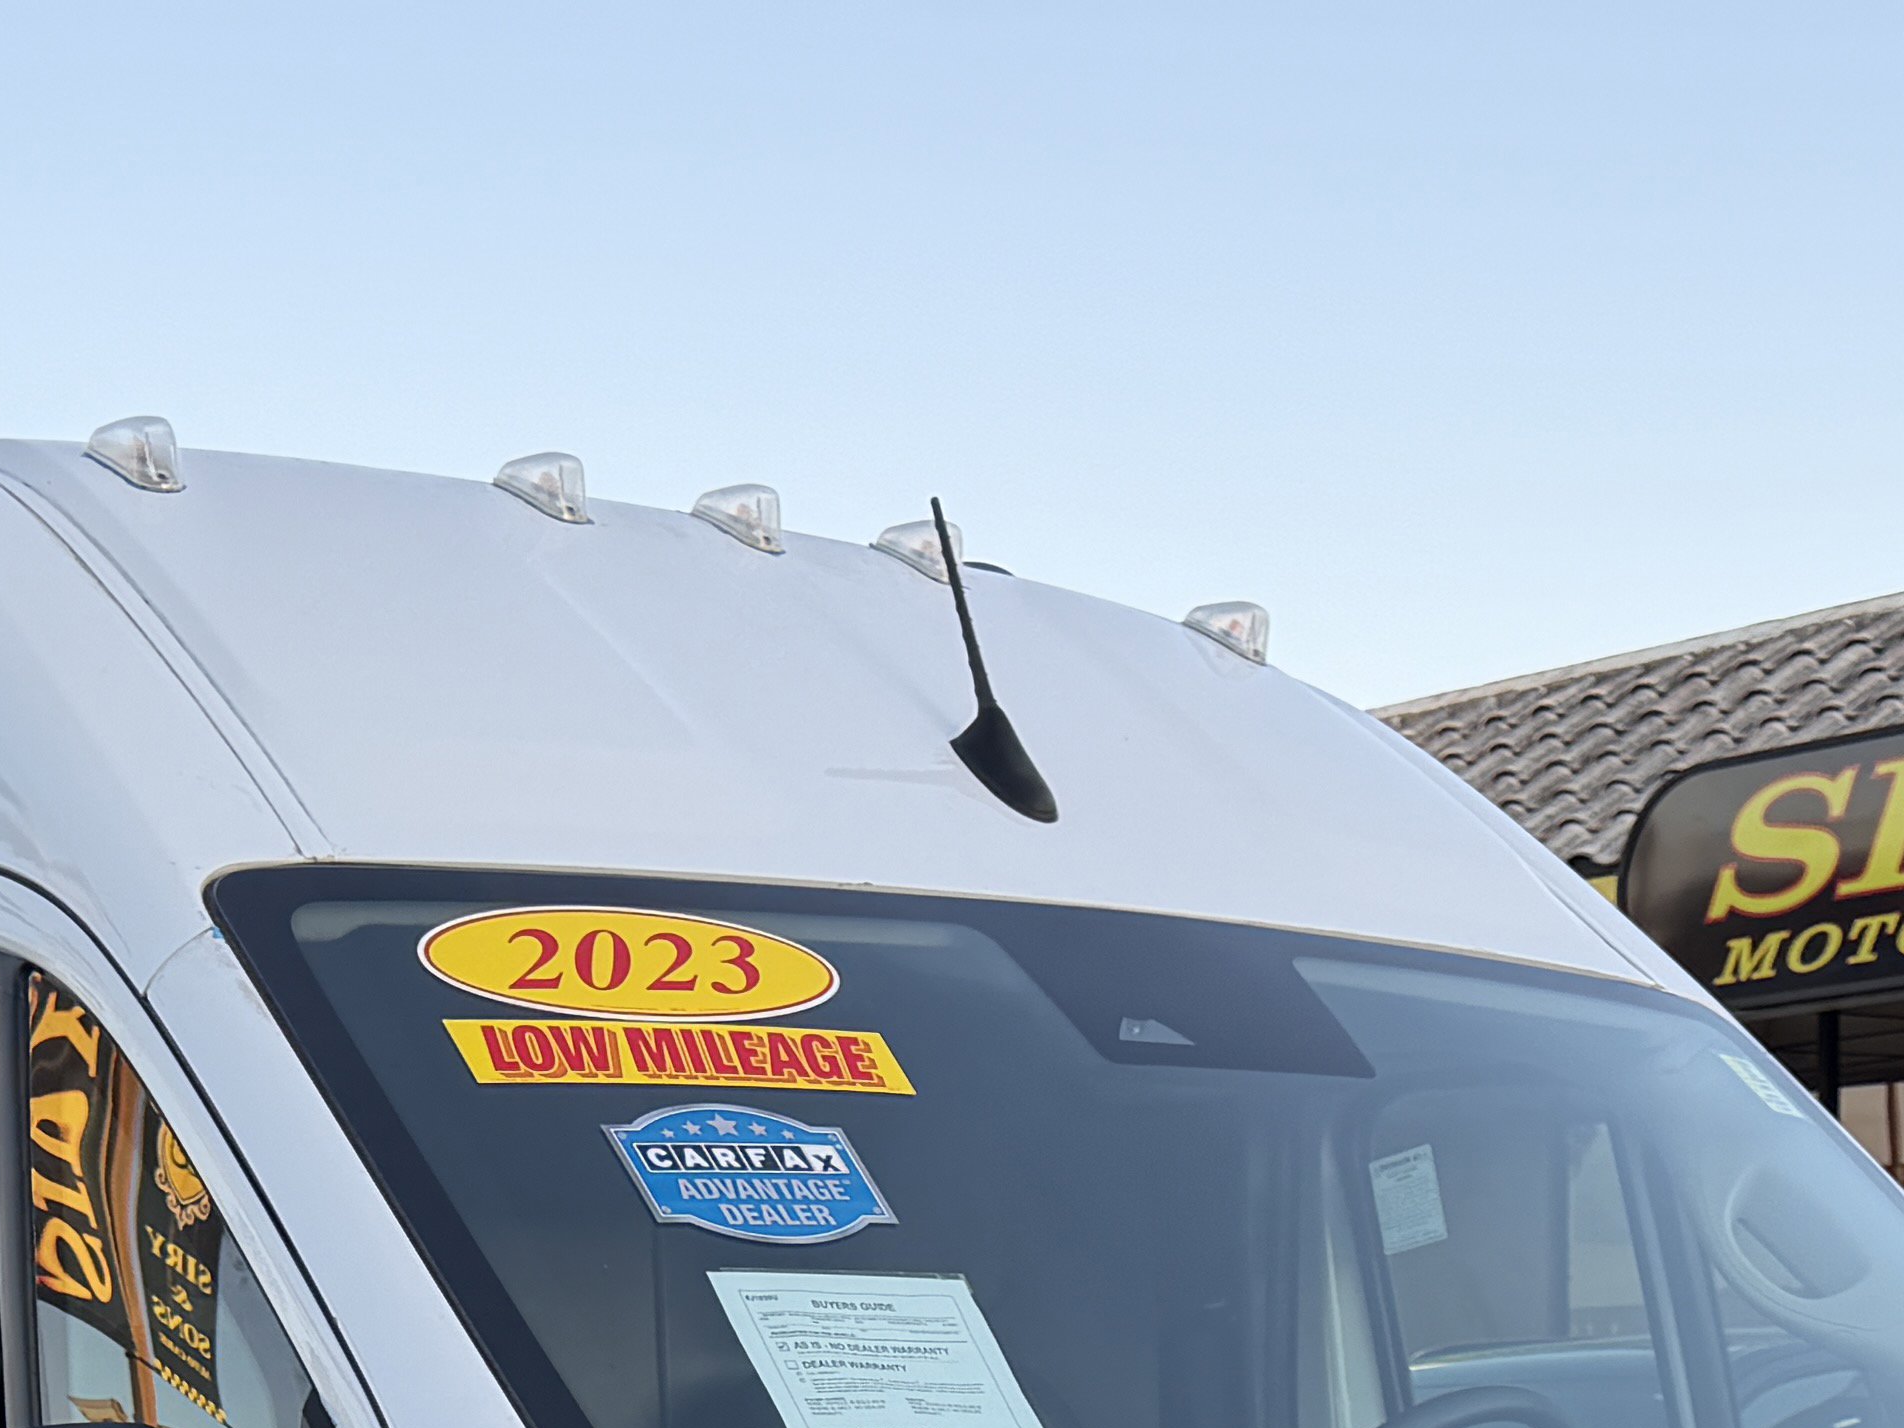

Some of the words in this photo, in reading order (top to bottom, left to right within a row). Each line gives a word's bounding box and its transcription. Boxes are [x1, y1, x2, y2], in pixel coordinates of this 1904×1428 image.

[507, 928, 761, 995] 2023
[481, 1024, 618, 1078] LOW
[623, 1026, 884, 1087] MILEAGE
[645, 1146, 842, 1173] CARFAX
[677, 1178, 851, 1201] ADVANTAGE
[718, 1203, 838, 1226] DEALER
[810, 1299, 858, 1311] BUYERS
[861, 1302, 897, 1313] GUIDE
[846, 1343, 890, 1354] DEALER
[801, 1360, 847, 1370] DEALER
